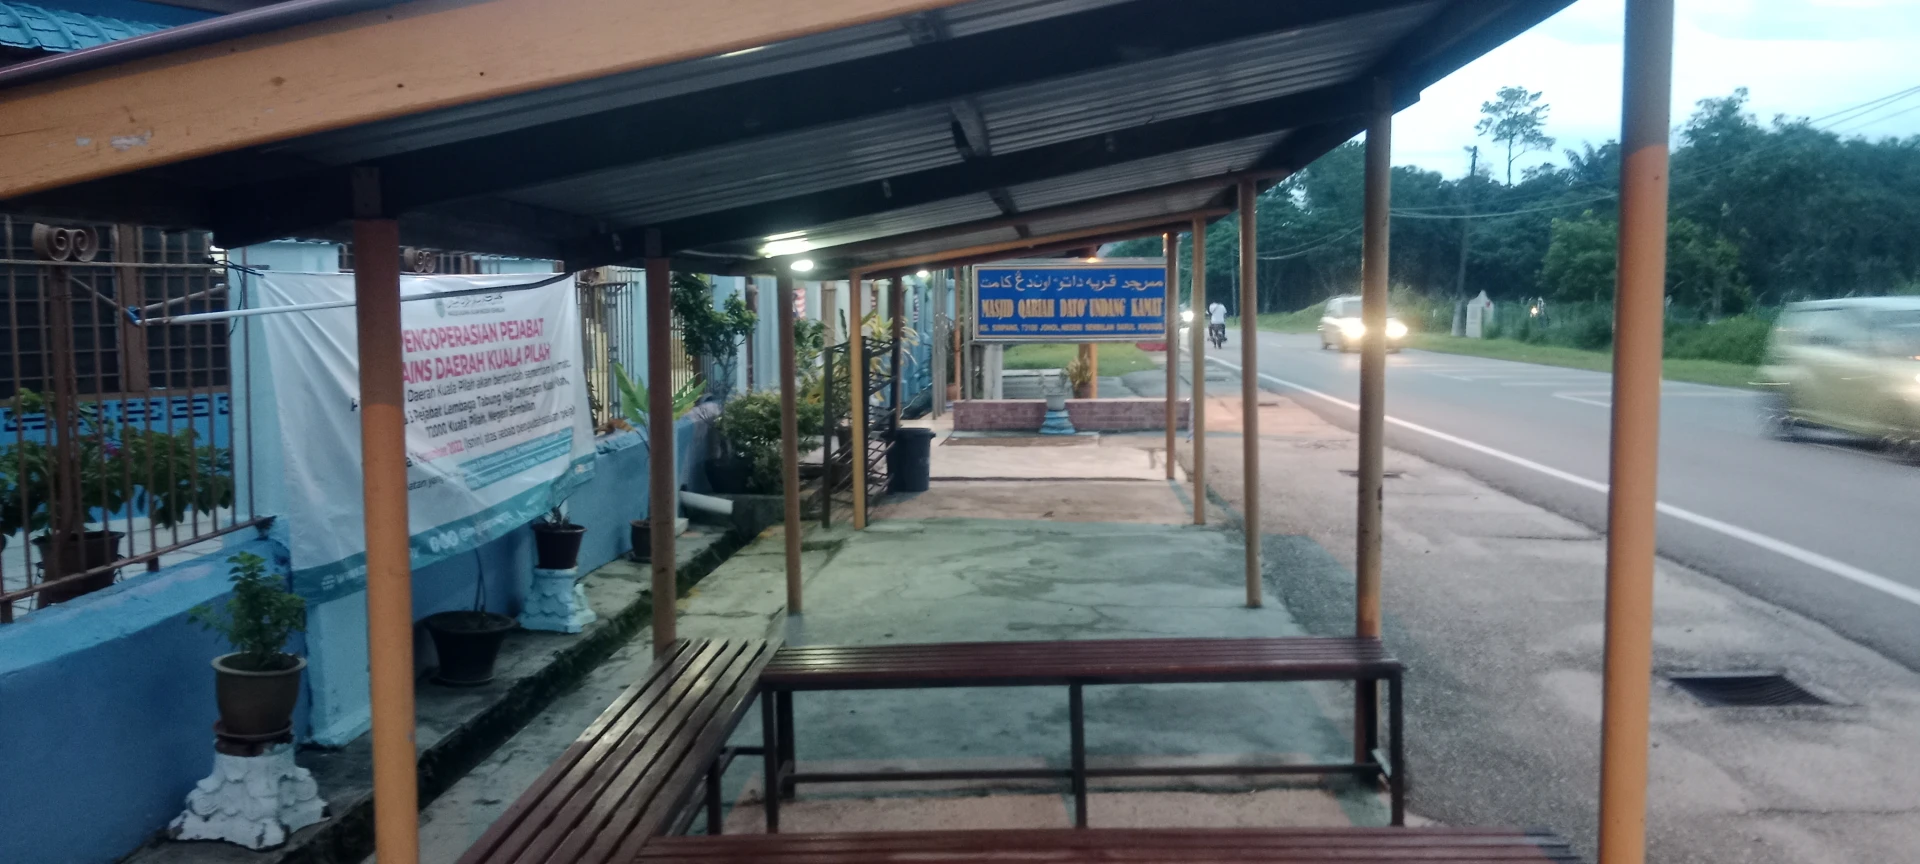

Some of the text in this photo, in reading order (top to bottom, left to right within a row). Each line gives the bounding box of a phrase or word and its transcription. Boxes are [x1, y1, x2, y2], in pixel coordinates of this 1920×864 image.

[981, 299, 1014, 319] MASJID
[1018, 298, 1055, 319] QARIAH
[1089, 298, 1126, 317] UNDANG
[1131, 297, 1163, 317] KAMAT
[402, 318, 544, 353] ENGOPERASIAN PEJABAT
[402, 359, 433, 384] AINS
[435, 352, 486, 380] DAERAH
[487, 346, 524, 372] KUALA
[525, 342, 551, 365] PILAH
[408, 386, 435, 402] Daerah
[437, 382, 457, 397] Kuala
[413, 404, 442, 424] Pejabat
[444, 400, 476, 415] Lembaga
[476, 394, 501, 408] Tabung
[448, 416, 468, 433] Kuala
